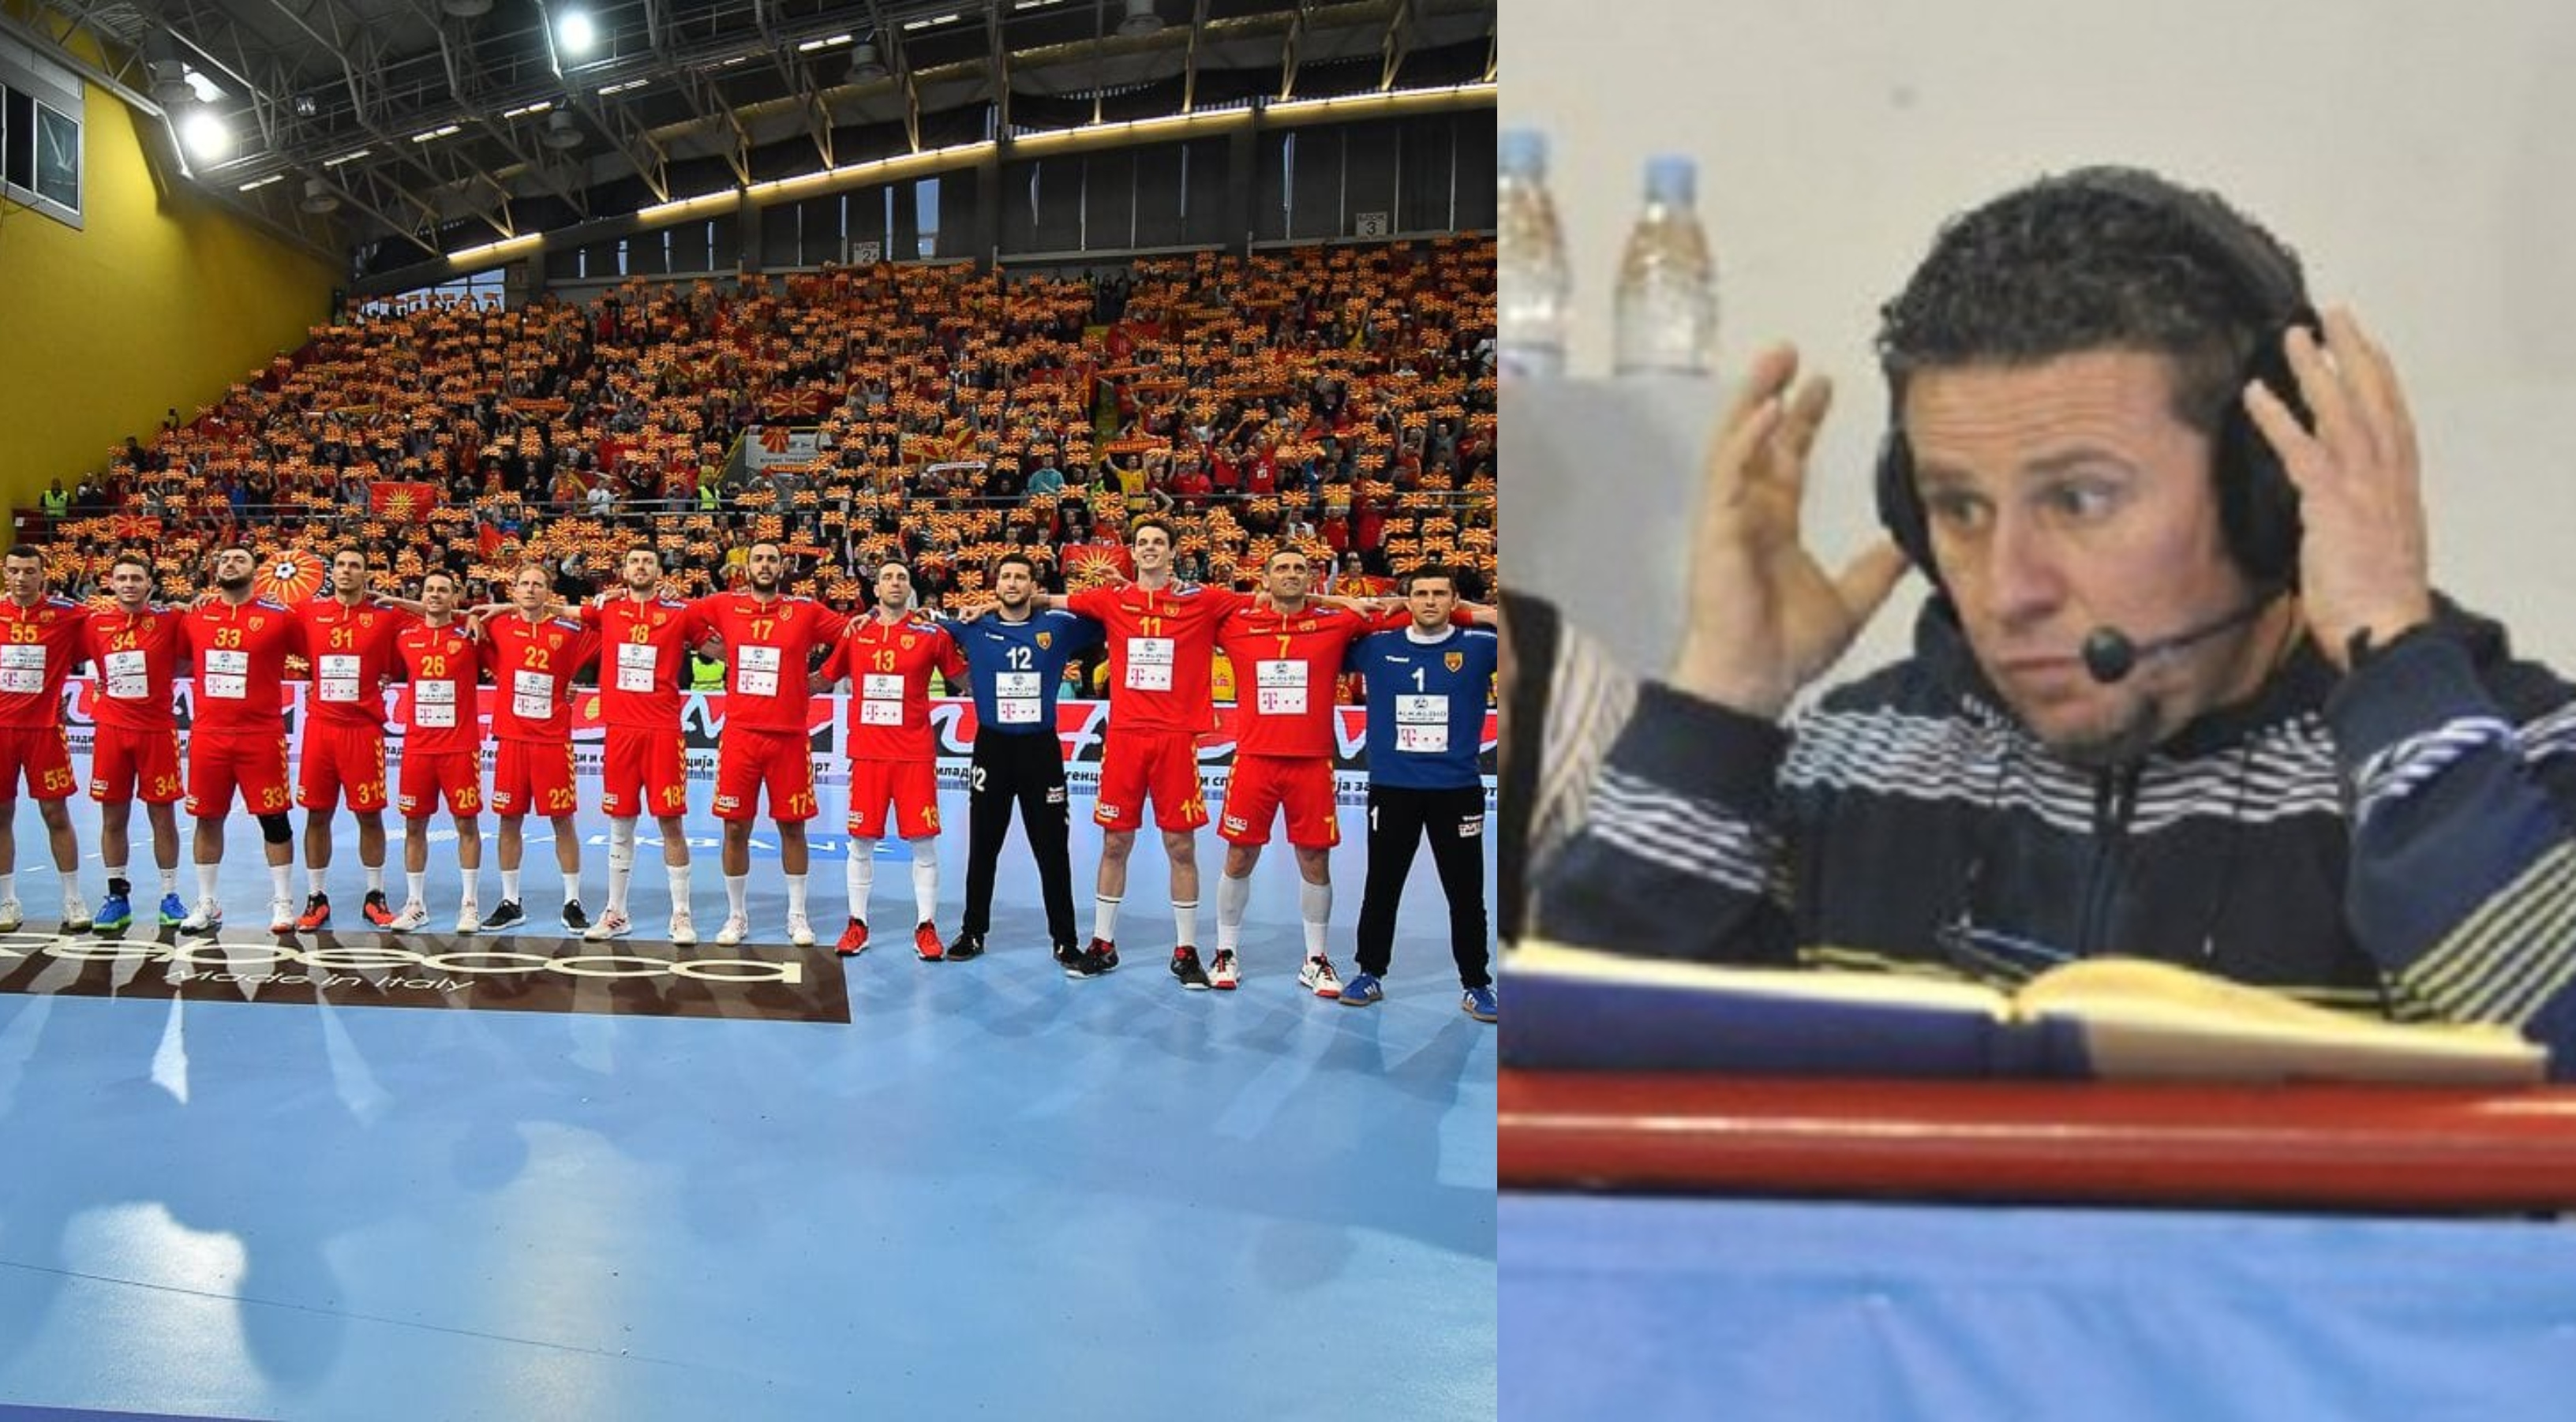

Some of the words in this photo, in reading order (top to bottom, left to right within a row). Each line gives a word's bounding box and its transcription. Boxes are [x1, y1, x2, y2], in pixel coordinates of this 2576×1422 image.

[1366, 222, 1376, 235] 3
[10, 623, 38, 643] 55
[214, 627, 242, 648] 33
[631, 623, 650, 644] 18
[751, 619, 774, 641] 17
[1139, 616, 1161, 637] 11
[111, 631, 137, 651] 34
[330, 627, 352, 649] 31
[1276, 634, 1292, 659] 7
[421, 656, 445, 676] 26
[524, 646, 549, 669] 22
[872, 649, 896, 672] 13
[1005, 646, 1032, 669] 12
[1412, 667, 1425, 692] 1
[44, 768, 70, 791] 55
[155, 773, 177, 796] 34
[972, 765, 987, 791] 12
[262, 788, 284, 808] 33
[358, 784, 379, 803] 31
[456, 788, 477, 808] 26
[549, 788, 570, 810] 22
[662, 785, 681, 807] 18
[789, 793, 808, 814] 17
[1324, 817, 1335, 840] 7
[1370, 806, 1379, 831] 1
[163, 970, 313, 984] Made
[374, 975, 476, 993] Italy
